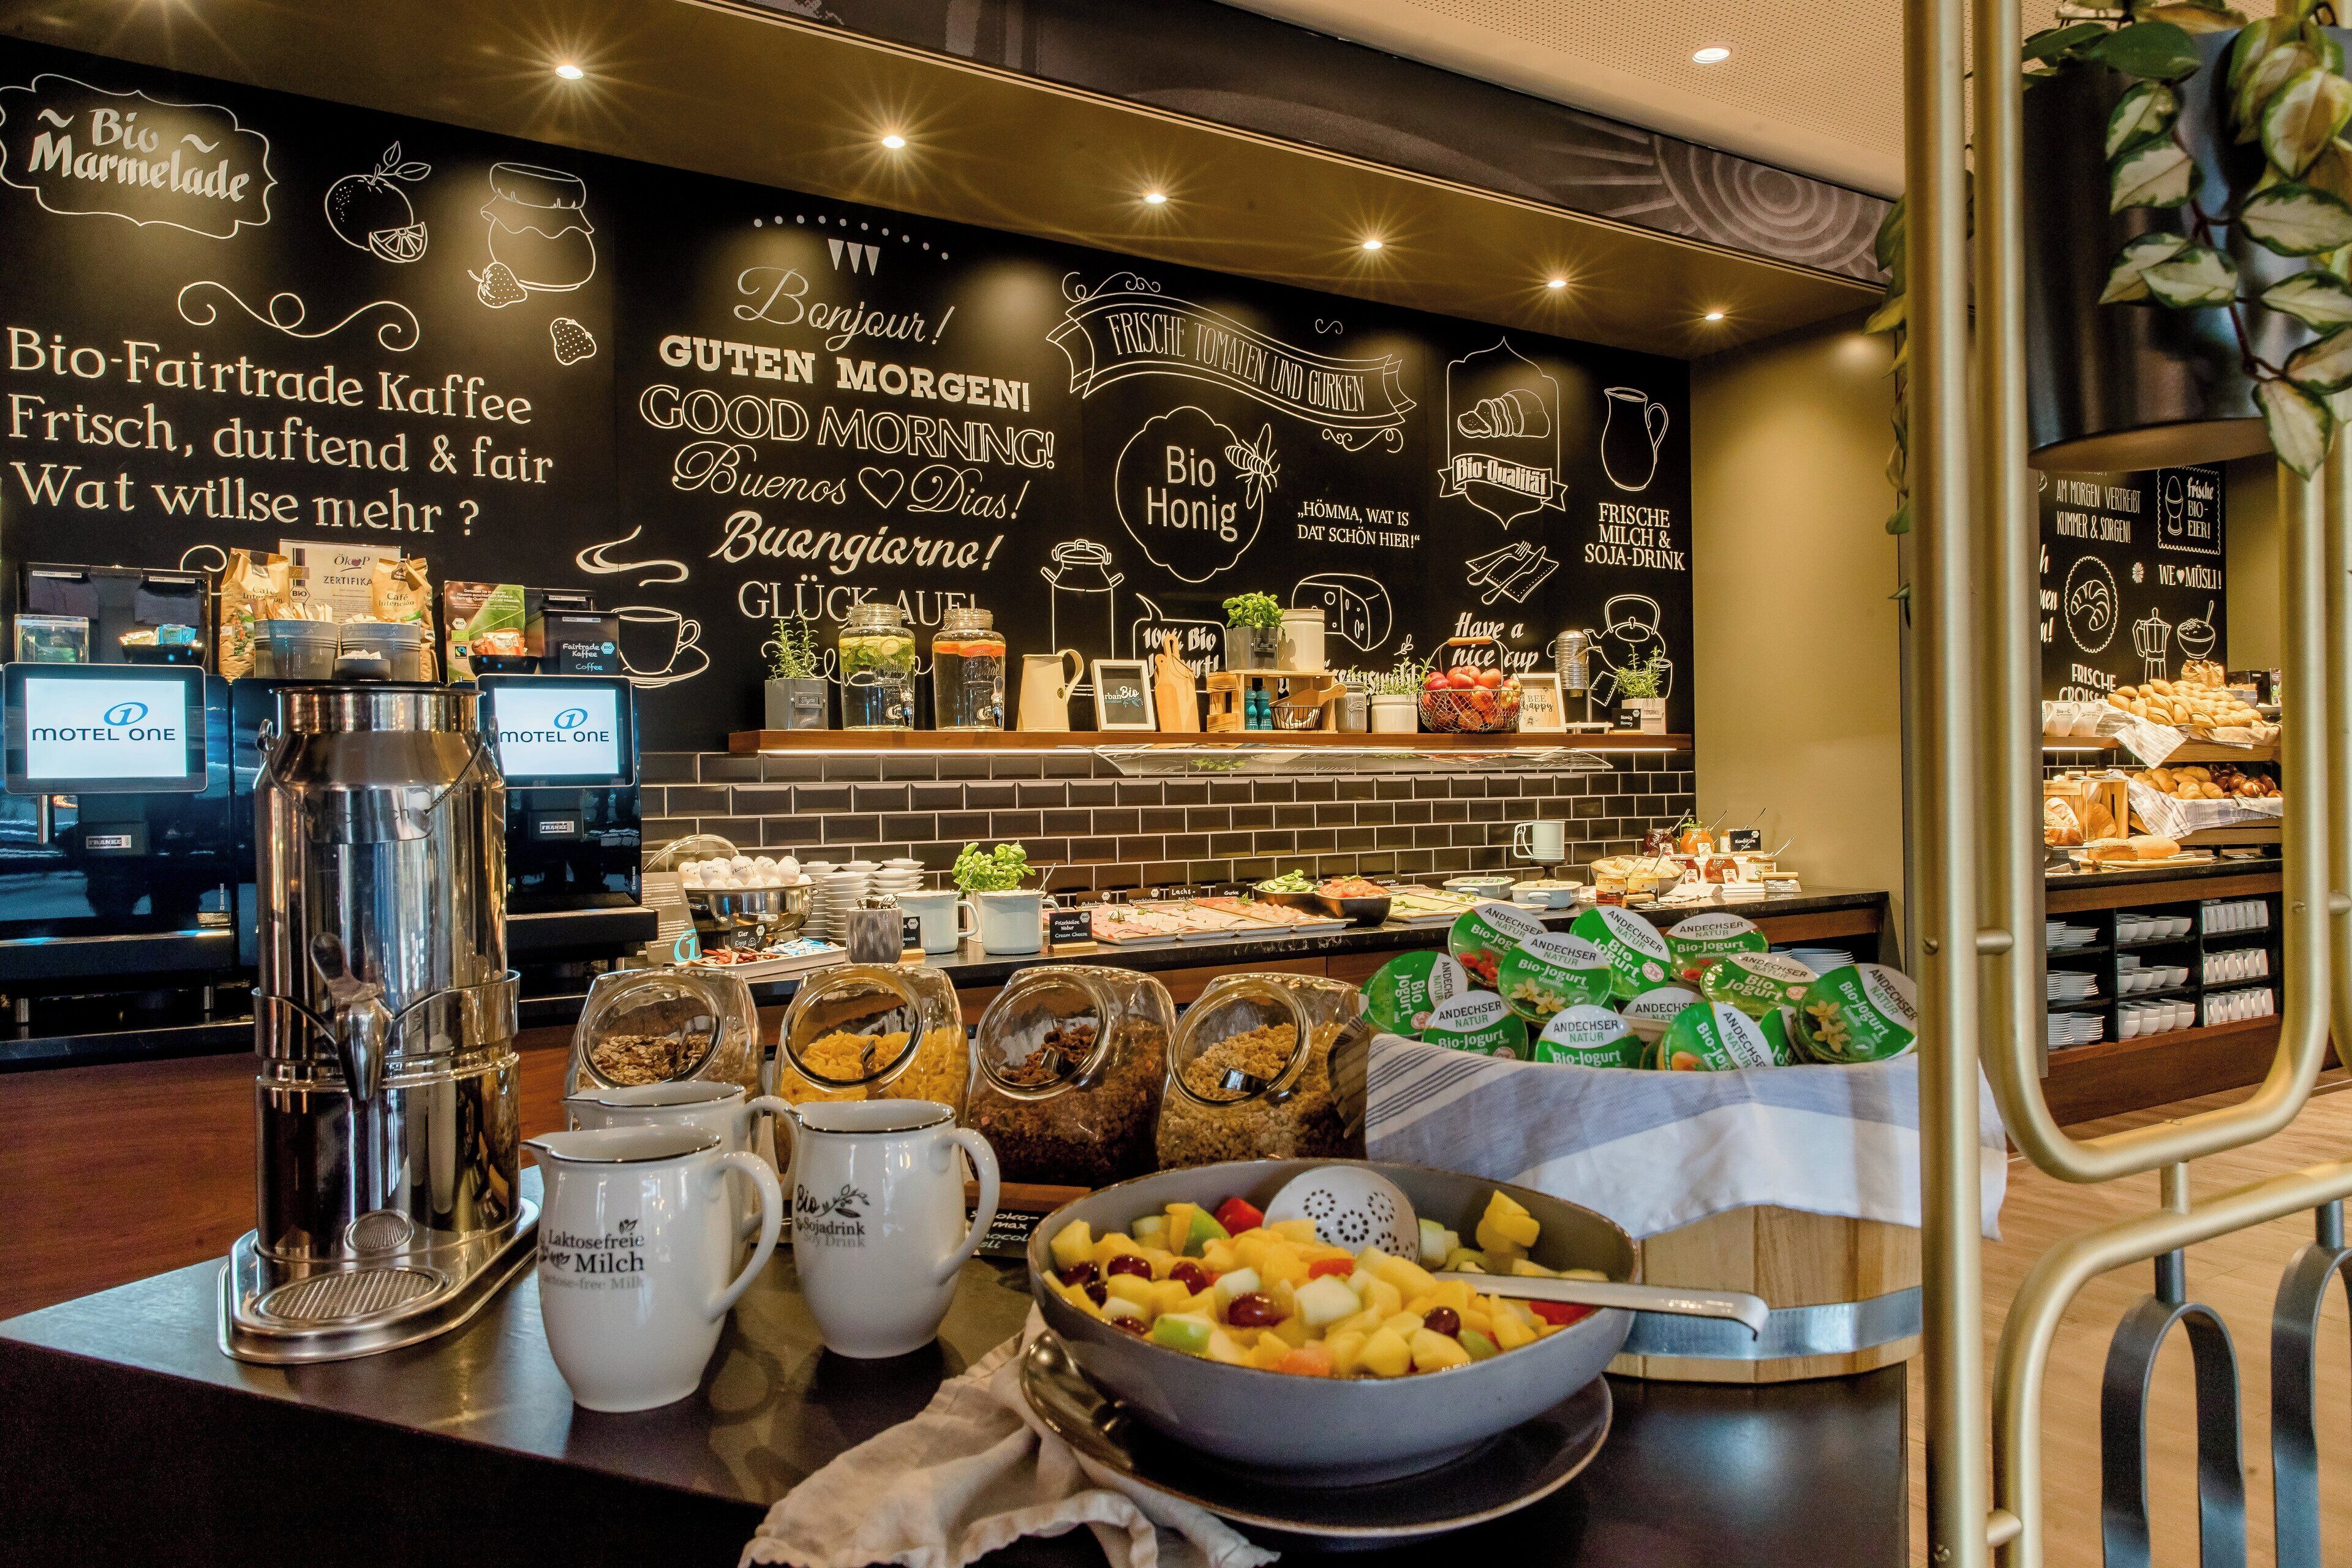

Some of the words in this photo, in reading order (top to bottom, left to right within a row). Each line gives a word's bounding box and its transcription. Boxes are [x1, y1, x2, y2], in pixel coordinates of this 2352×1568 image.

[91, 108, 159, 154] Bio
[29, 130, 251, 202] Marmelade
[660, 334, 815, 385] GUTEN
[836, 356, 1030, 412] MORGEN!
[1106, 312, 1186, 358] FRISCHE
[1194, 322, 1268, 385] TOMATEN
[1270, 360, 1303, 400] UND
[1308, 368, 1364, 412] GURKEN
[7, 327, 364, 407] Bio-Fairtrade
[379, 372, 532, 425] Kaffee
[640, 384, 809, 441] GOOD
[817, 406, 1055, 469] MORNING!
[8, 394, 194, 458] Frisch,
[213, 418, 408, 473] duftend
[429, 435, 457, 474] &
[472, 437, 553, 484] fair
[1166, 445, 1216, 488] Bio
[1456, 456, 1548, 496] Bio-Qualität
[673, 440, 846, 505] Buenos
[907, 464, 1030, 519] Dias!
[2187, 477, 2214, 500] frische
[10, 462, 135, 511] Wat
[152, 475, 299, 524] willse
[312, 490, 441, 533] mehr
[459, 500, 479, 536] ?
[2057, 480, 2067, 502] AM
[2070, 481, 2100, 508] MORGEN
[2105, 486, 2141, 514] VERTREIBT
[1147, 486, 1238, 543] Honig
[1366, 507, 1393, 524] WAT
[1395, 510, 1409, 526] IS
[1599, 503, 1670, 528] FRISCHE
[1297, 524, 1325, 541] DAT
[1329, 525, 1376, 546] SCHÖN
[1599, 524, 1654, 547] MILCH
[1659, 530, 1672, 548] &
[2057, 511, 2088, 538] KUMMER
[2090, 515, 2098, 539] &
[2100, 517, 2131, 543] SORGEN!
[2187, 520, 2211, 539] EIER!
[1585, 543, 1686, 570] SOJA-DRINK
[323, 576, 372, 586] ZERTIFIKA
[2159, 565, 2175, 586] WE
[2185, 565, 2222, 589] MÜSLI!
[387, 592, 409, 601] Café
[1455, 612, 1504, 639] Have
[1511, 623, 1524, 638] a
[1188, 626, 1216, 651] Bio
[572, 650, 598, 659] Kaffee
[1452, 644, 1495, 667] nice
[1504, 651, 1539, 674] cup
[575, 662, 603, 672] Coffee
[2071, 663, 2116, 693] FRISCHE
[1120, 685, 1139, 699] Bio
[1521, 701, 1553, 712] happy
[32, 728, 119, 742] MOTEL
[500, 731, 567, 743] MOTEL
[1485, 908, 1543, 935] ANDECHSER
[1495, 920, 1526, 938] NATUR
[1607, 911, 1663, 952] ANDECHSER
[1679, 921, 1744, 933] ANDECHSER
[1471, 924, 1513, 951] Bio-Jog
[1608, 938, 1633, 961] Bio
[1615, 926, 1645, 949] NATUR
[1677, 940, 1744, 953] Bio-Jogurt
[1531, 939, 1597, 961] ANDECHSER
[1544, 951, 1578, 967] NATUR
[1593, 938, 1640, 978] Jogurt
[1518, 959, 1588, 986] Bio-Jogurt
[1741, 956, 1807, 978] ANDECHSER
[1752, 964, 1788, 979] NATUR
[1411, 980, 1425, 1003] Bio
[1434, 975, 1443, 1001] NATUR
[1442, 962, 1453, 999] ANDECHS
[1722, 979, 1784, 1001] Jogurt
[1745, 974, 1775, 990] Bio
[1394, 974, 1414, 1016] Jogurt
[1869, 968, 1918, 1021] ANDECHSER
[1870, 986, 1899, 1015] NATUR
[1439, 1001, 1502, 1020] ANDECHSER
[1635, 1003, 1695, 1013] ANDECHS
[1839, 981, 1890, 1038] Bio-Jogurt
[1455, 1014, 1488, 1028] NATUR
[1554, 1020, 1619, 1032] ANDECHSER
[1438, 1028, 1504, 1050] Bio-Jogurt
[1569, 1032, 1604, 1042] NATUR
[1696, 1022, 1732, 1071] Bio-Jog
[1723, 1012, 1765, 1068] ANDECHSE
[1553, 1050, 1622, 1067] Bio-Jogurt
[1724, 1032, 1751, 1069] NATUR
[797, 1184, 820, 1214] Bio
[549, 1229, 644, 1249] Laktosefreie
[575, 1251, 644, 1273] Milch
